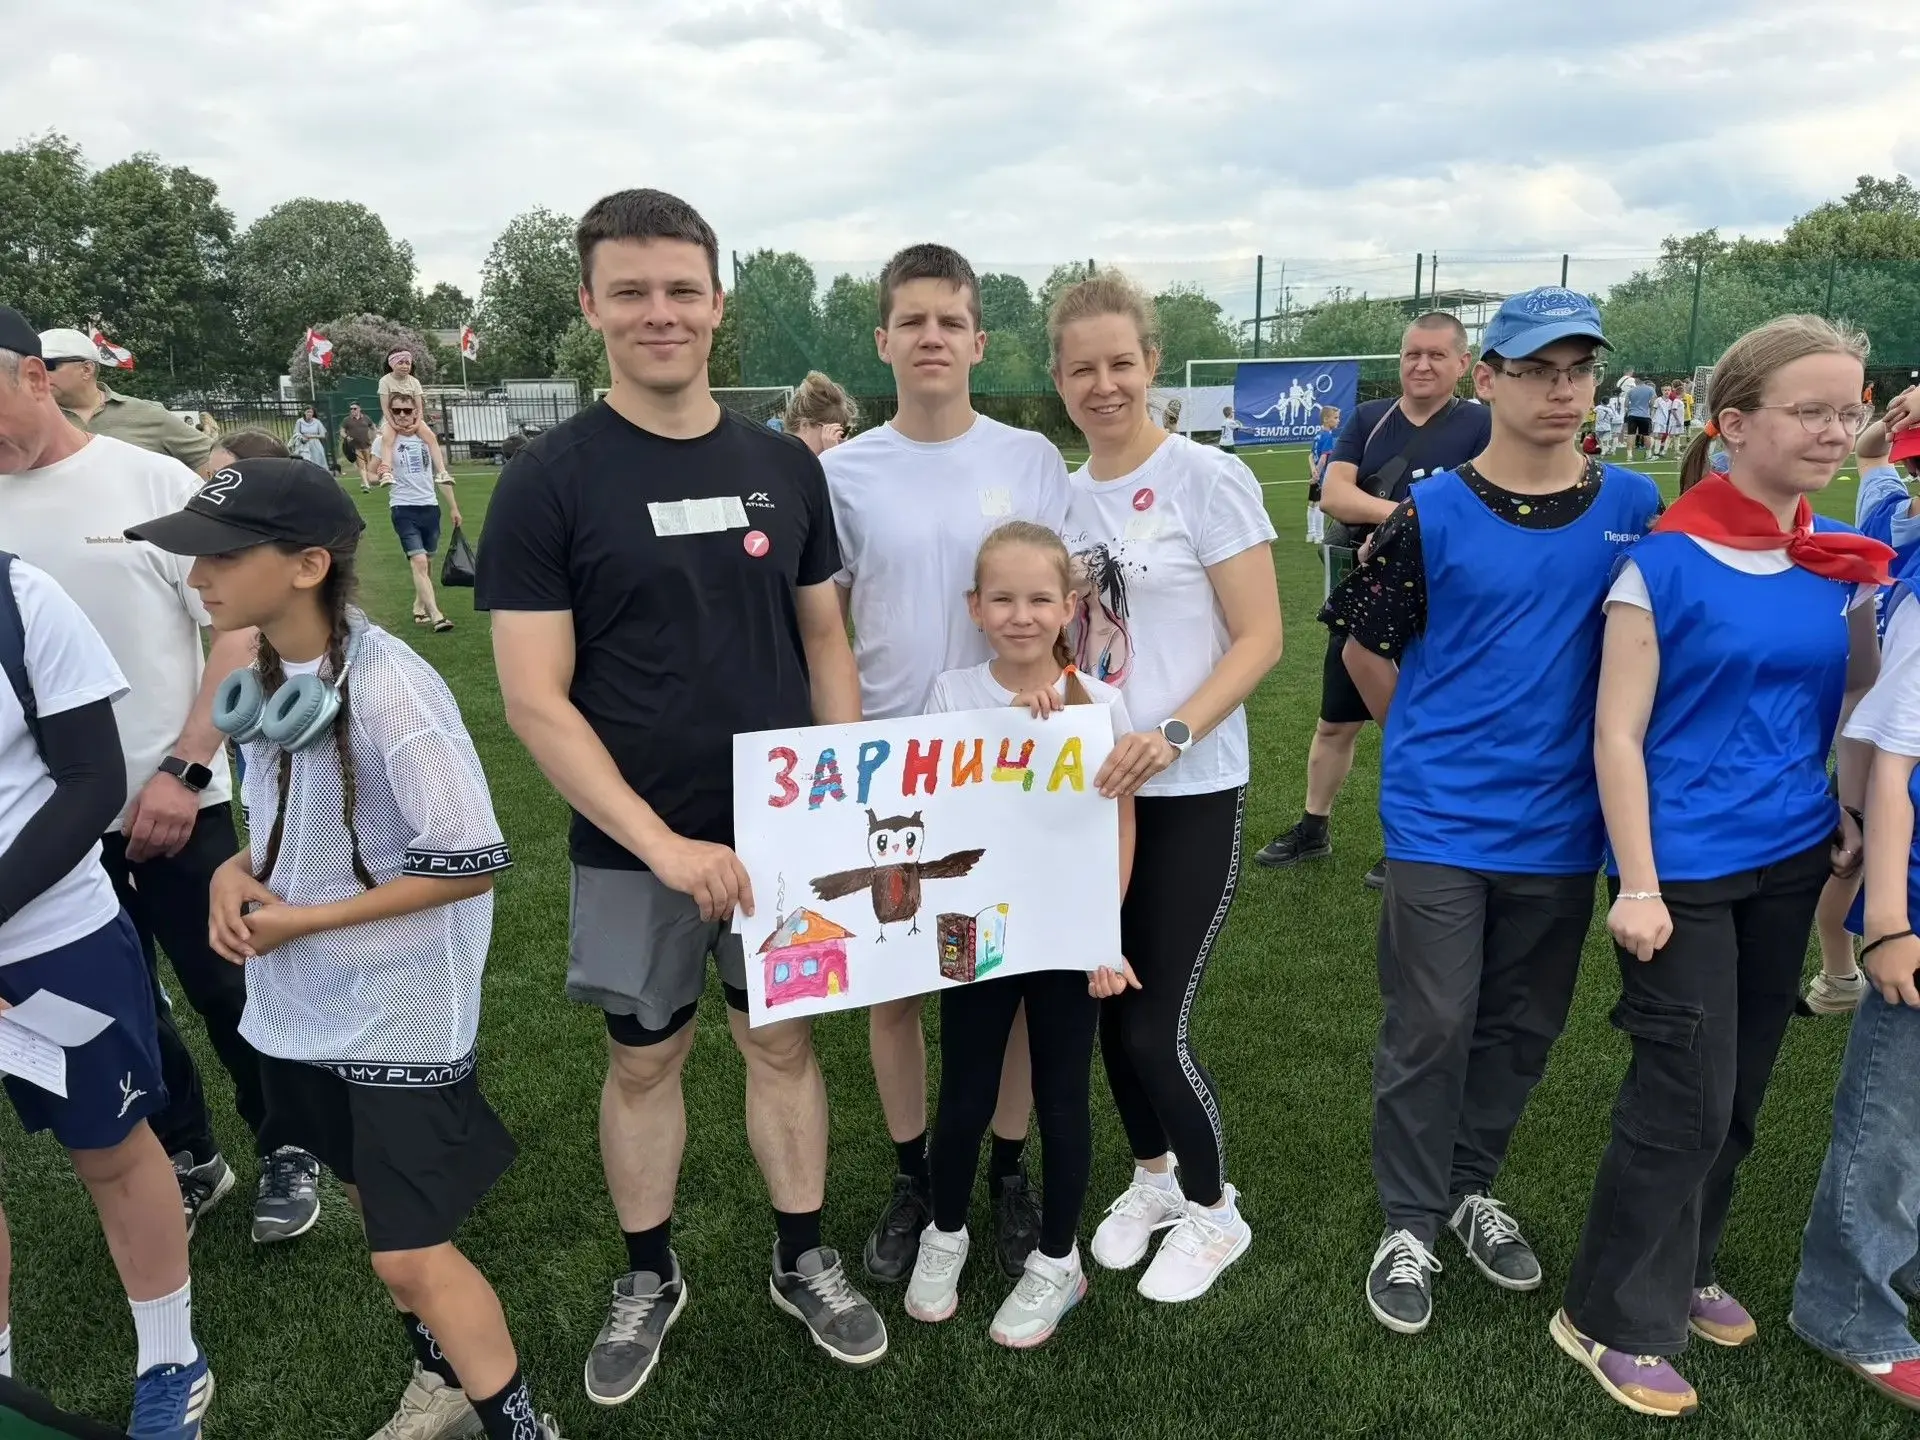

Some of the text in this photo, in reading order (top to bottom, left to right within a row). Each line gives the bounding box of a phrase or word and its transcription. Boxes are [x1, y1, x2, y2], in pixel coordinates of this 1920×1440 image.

[1254, 425, 1322, 437] ЗЕМЛЯ СПОР
[745, 501, 775, 509] ATHLEX
[768, 737, 1085, 810] ЗАРНИЦА
[404, 855, 425, 868] MY
[1225, 808, 1243, 889] FREEDOM
[1195, 895, 1231, 967] FREEDOM
[1179, 973, 1199, 1042] FREEDOM
[351, 1067, 381, 1081] MY
[386, 1066, 459, 1082] PLAN
[1178, 1042, 1207, 1099] FREEDOM
